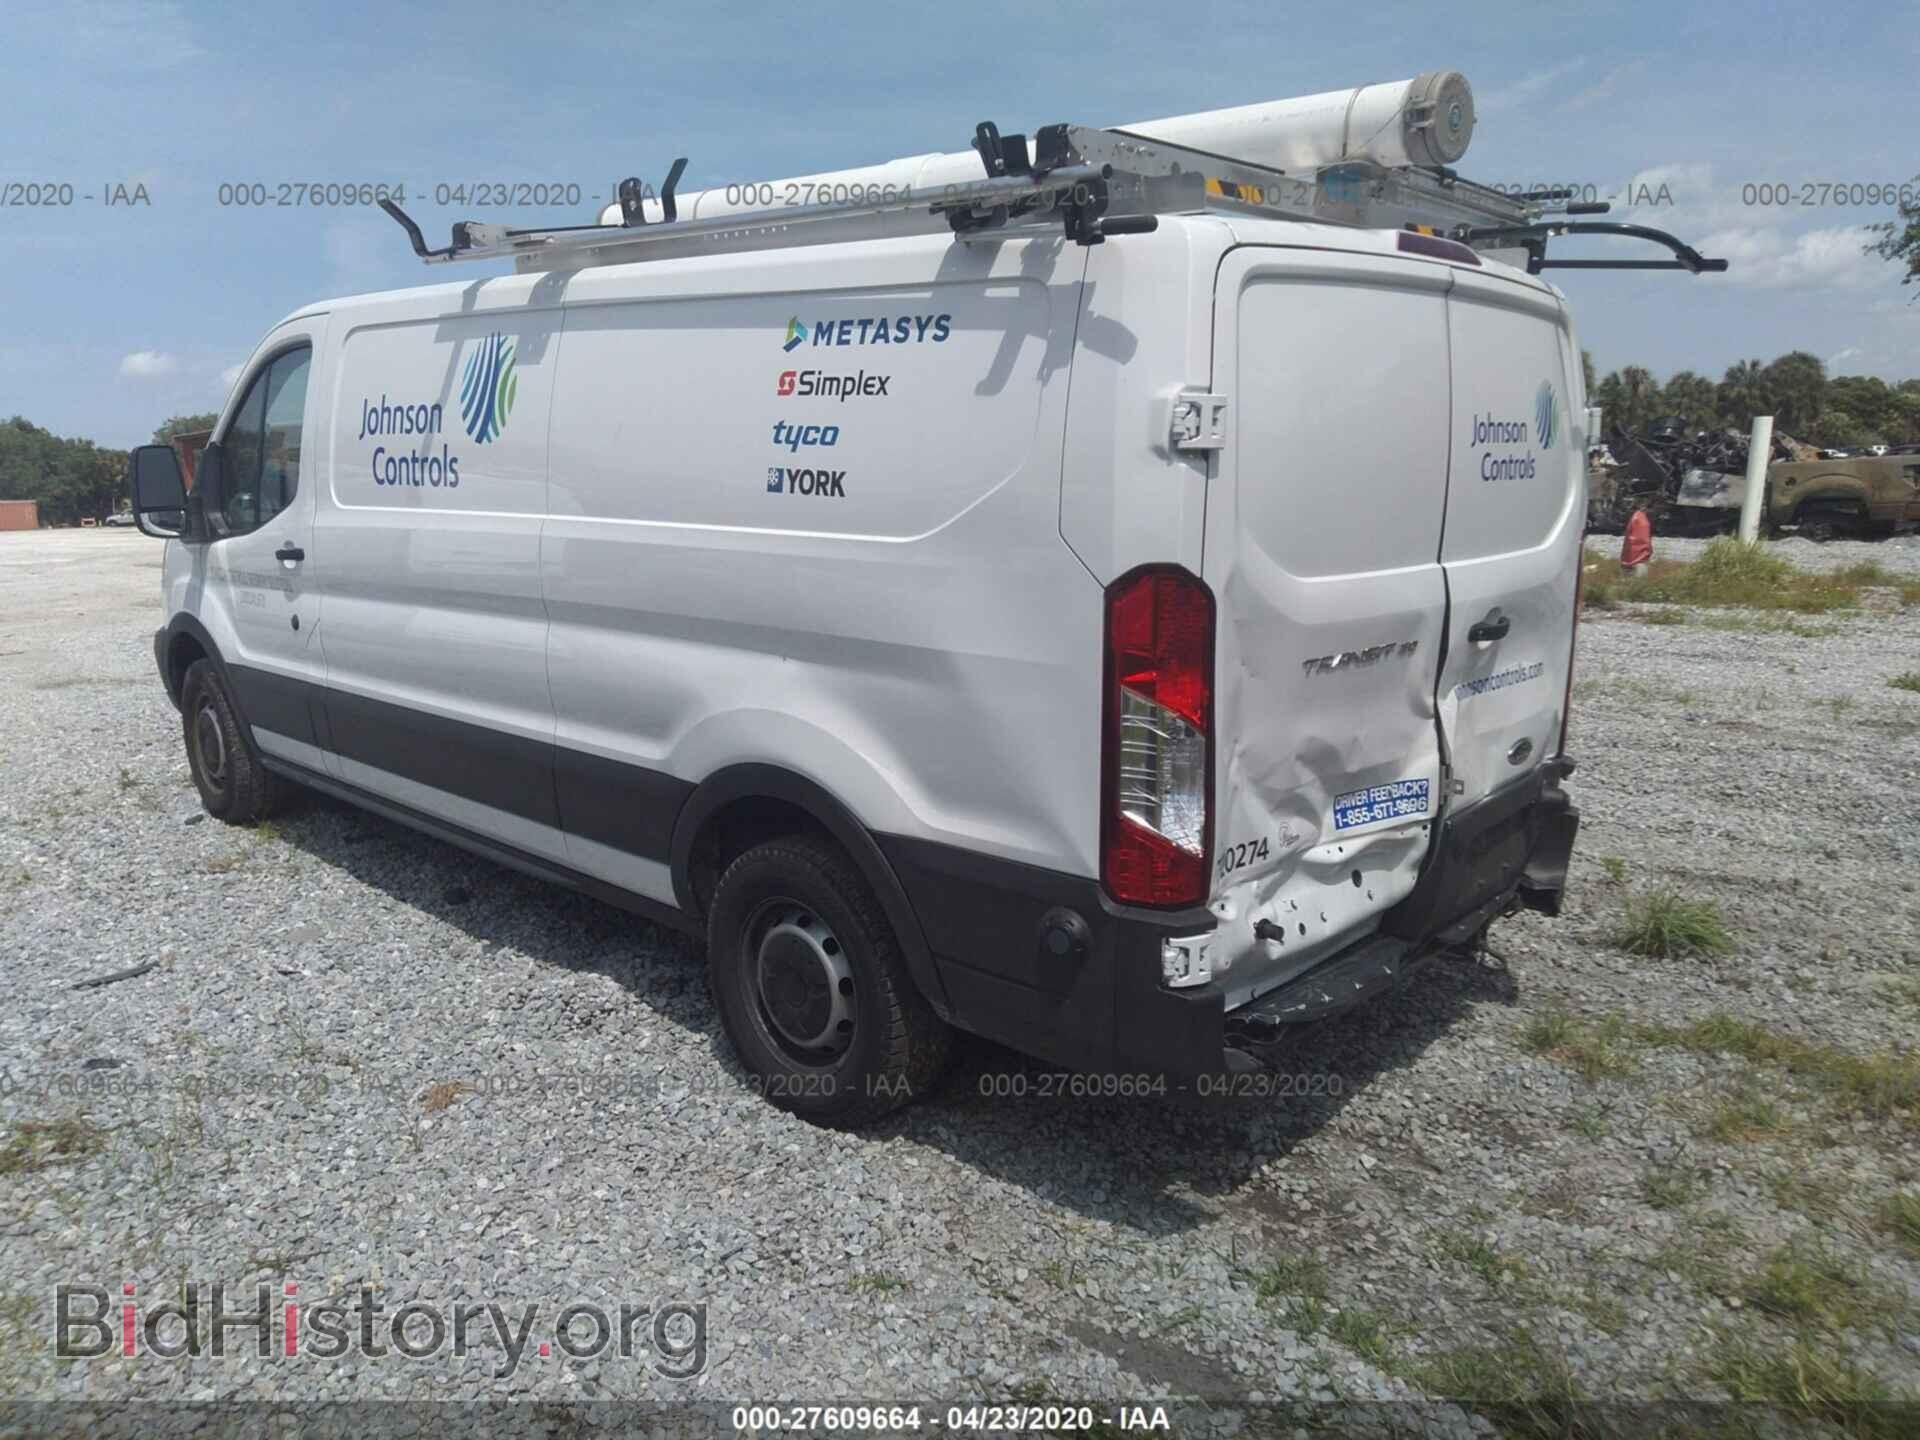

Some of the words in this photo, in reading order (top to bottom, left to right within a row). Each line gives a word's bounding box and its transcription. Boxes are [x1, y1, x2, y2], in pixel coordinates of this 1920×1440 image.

[813, 314, 952, 346] METASYS
[797, 369, 891, 402] Simplex
[359, 394, 442, 440] Johnson
[1471, 411, 1527, 448] Johnson
[773, 420, 840, 452] tyco
[373, 443, 459, 487] Controls
[1481, 449, 1535, 481] Controls
[787, 468, 847, 498] YORK
